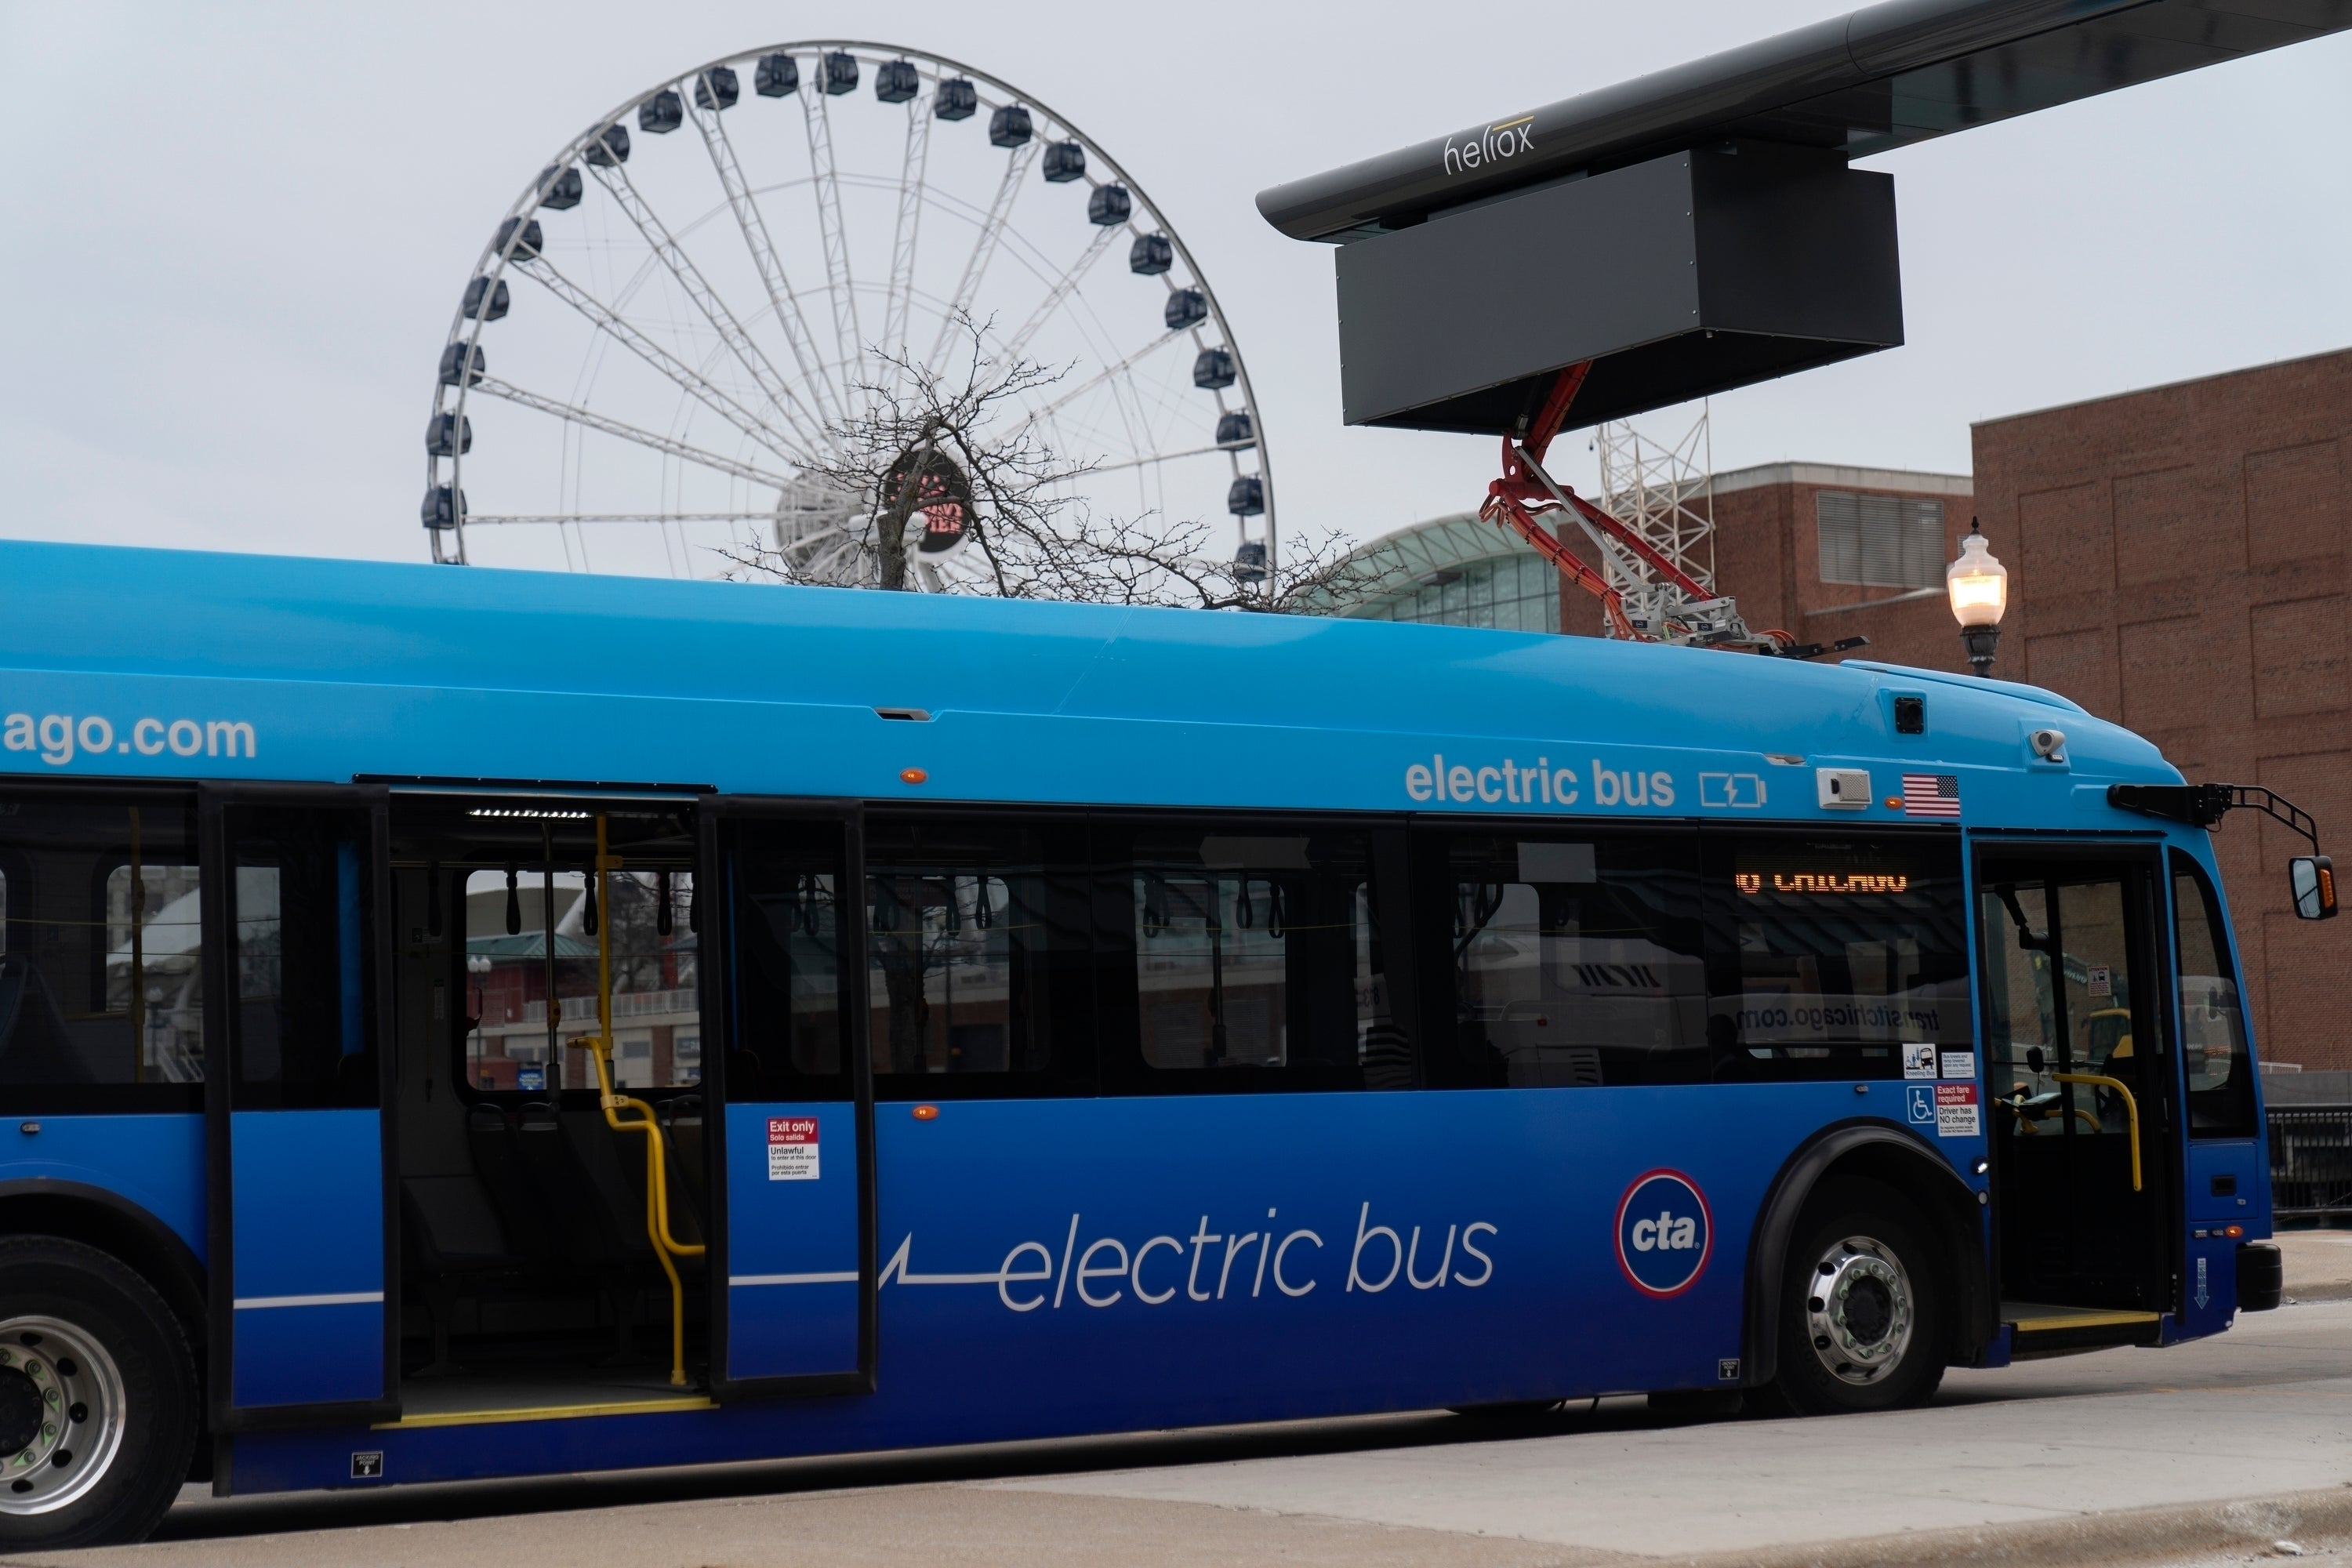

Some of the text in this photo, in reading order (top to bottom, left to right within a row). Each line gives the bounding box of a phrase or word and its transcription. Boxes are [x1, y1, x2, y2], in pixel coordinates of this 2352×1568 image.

[1444, 123, 1535, 176] heliox
[3, 713, 256, 766] ago.com
[1406, 754, 1675, 807] electric bus
[1937, 1085, 1970, 1094] Exact fare
[1938, 1094, 1965, 1104] required
[1939, 1105, 1973, 1115] Driver has
[1951, 1115, 1976, 1125] change
[770, 1120, 815, 1134] Exit only
[771, 1146, 804, 1155] Unlawful
[998, 1200, 1498, 1312] electric bus
